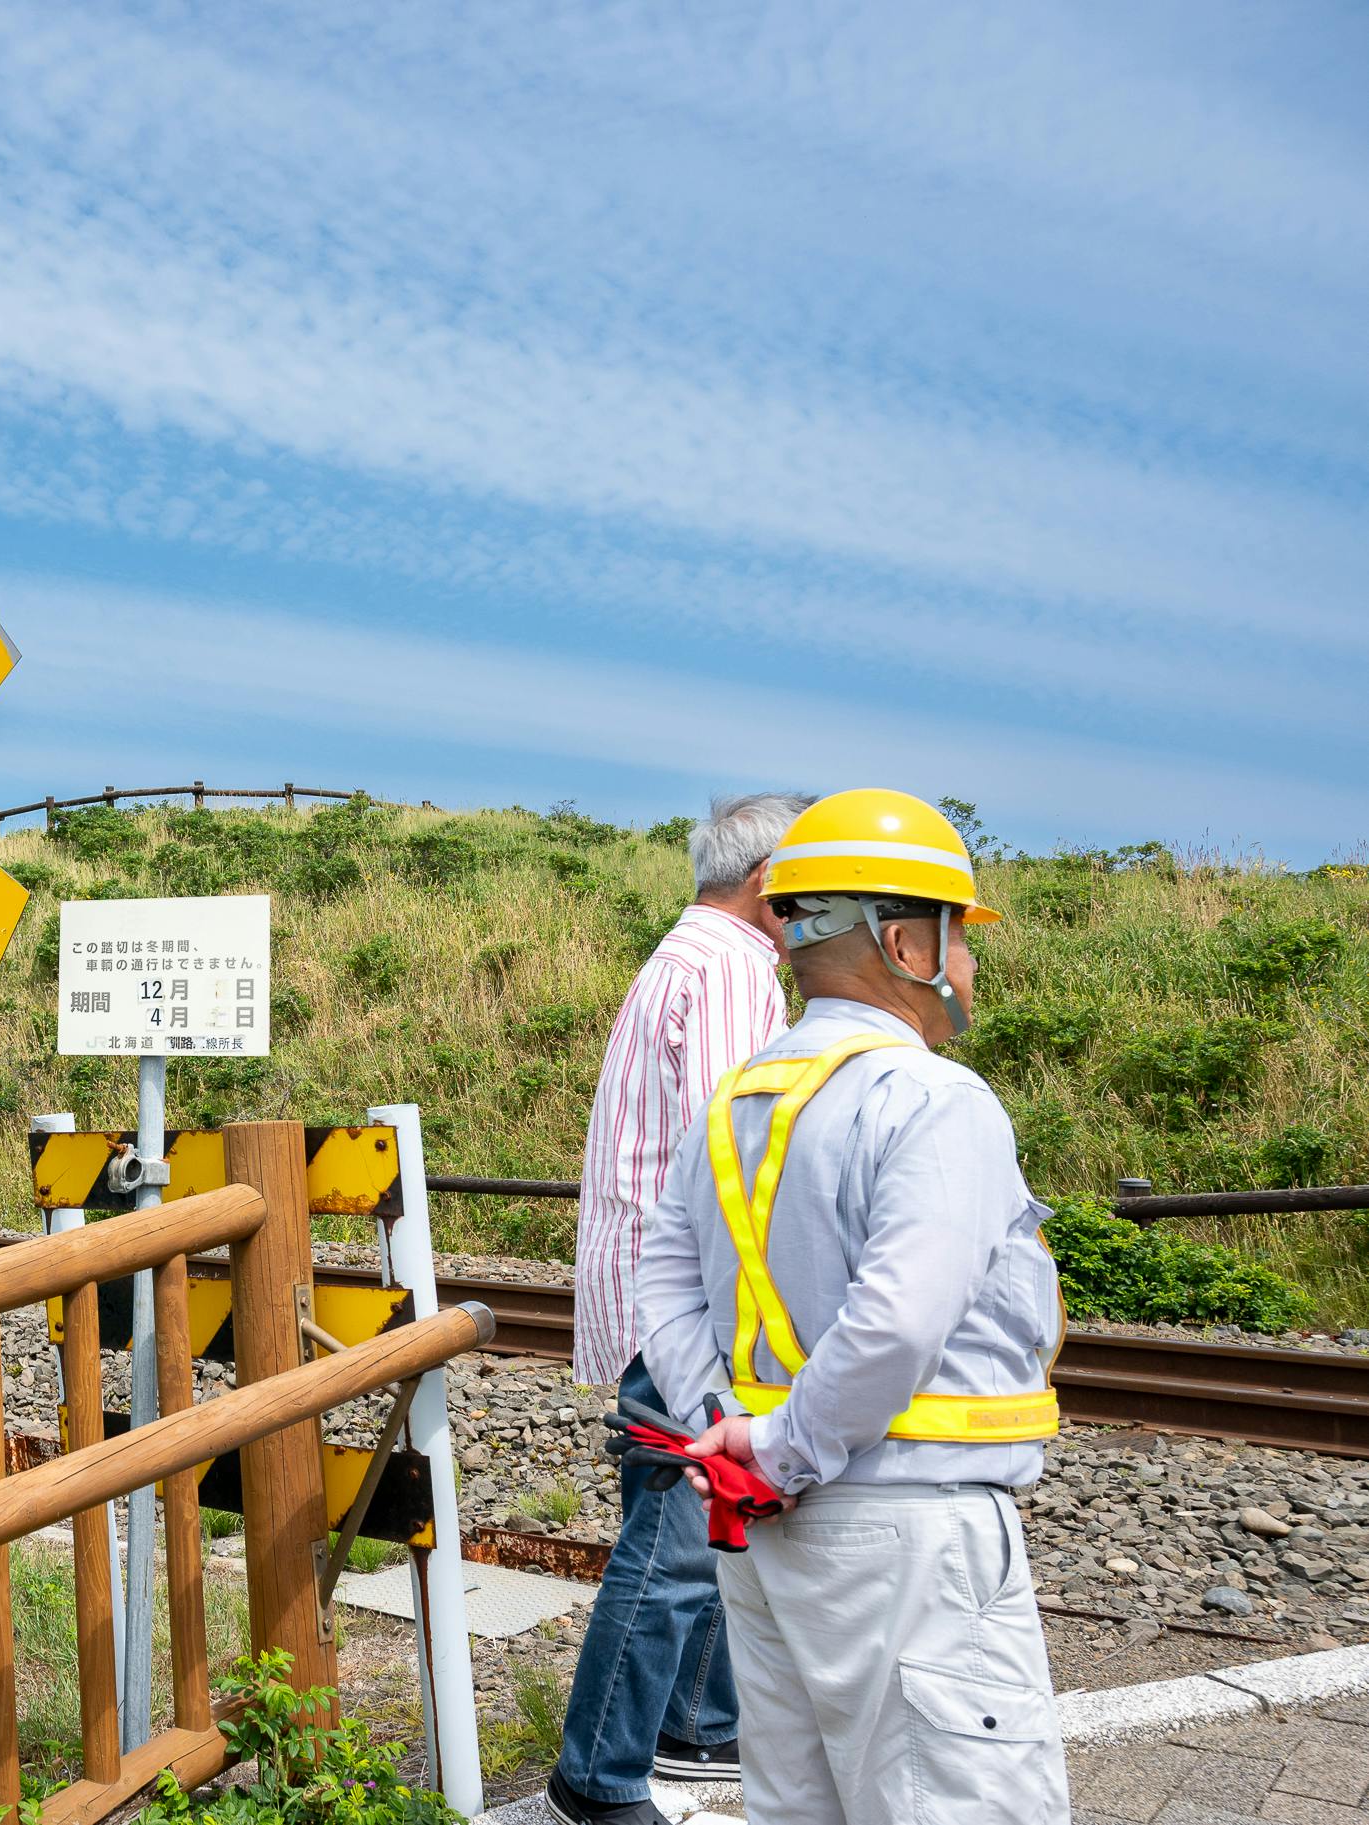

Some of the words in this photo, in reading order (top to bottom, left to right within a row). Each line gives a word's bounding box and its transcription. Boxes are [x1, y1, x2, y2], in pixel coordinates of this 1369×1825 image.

[72, 939, 199, 954] この踏切は冬期間、
[70, 991, 111, 1013] 期間
